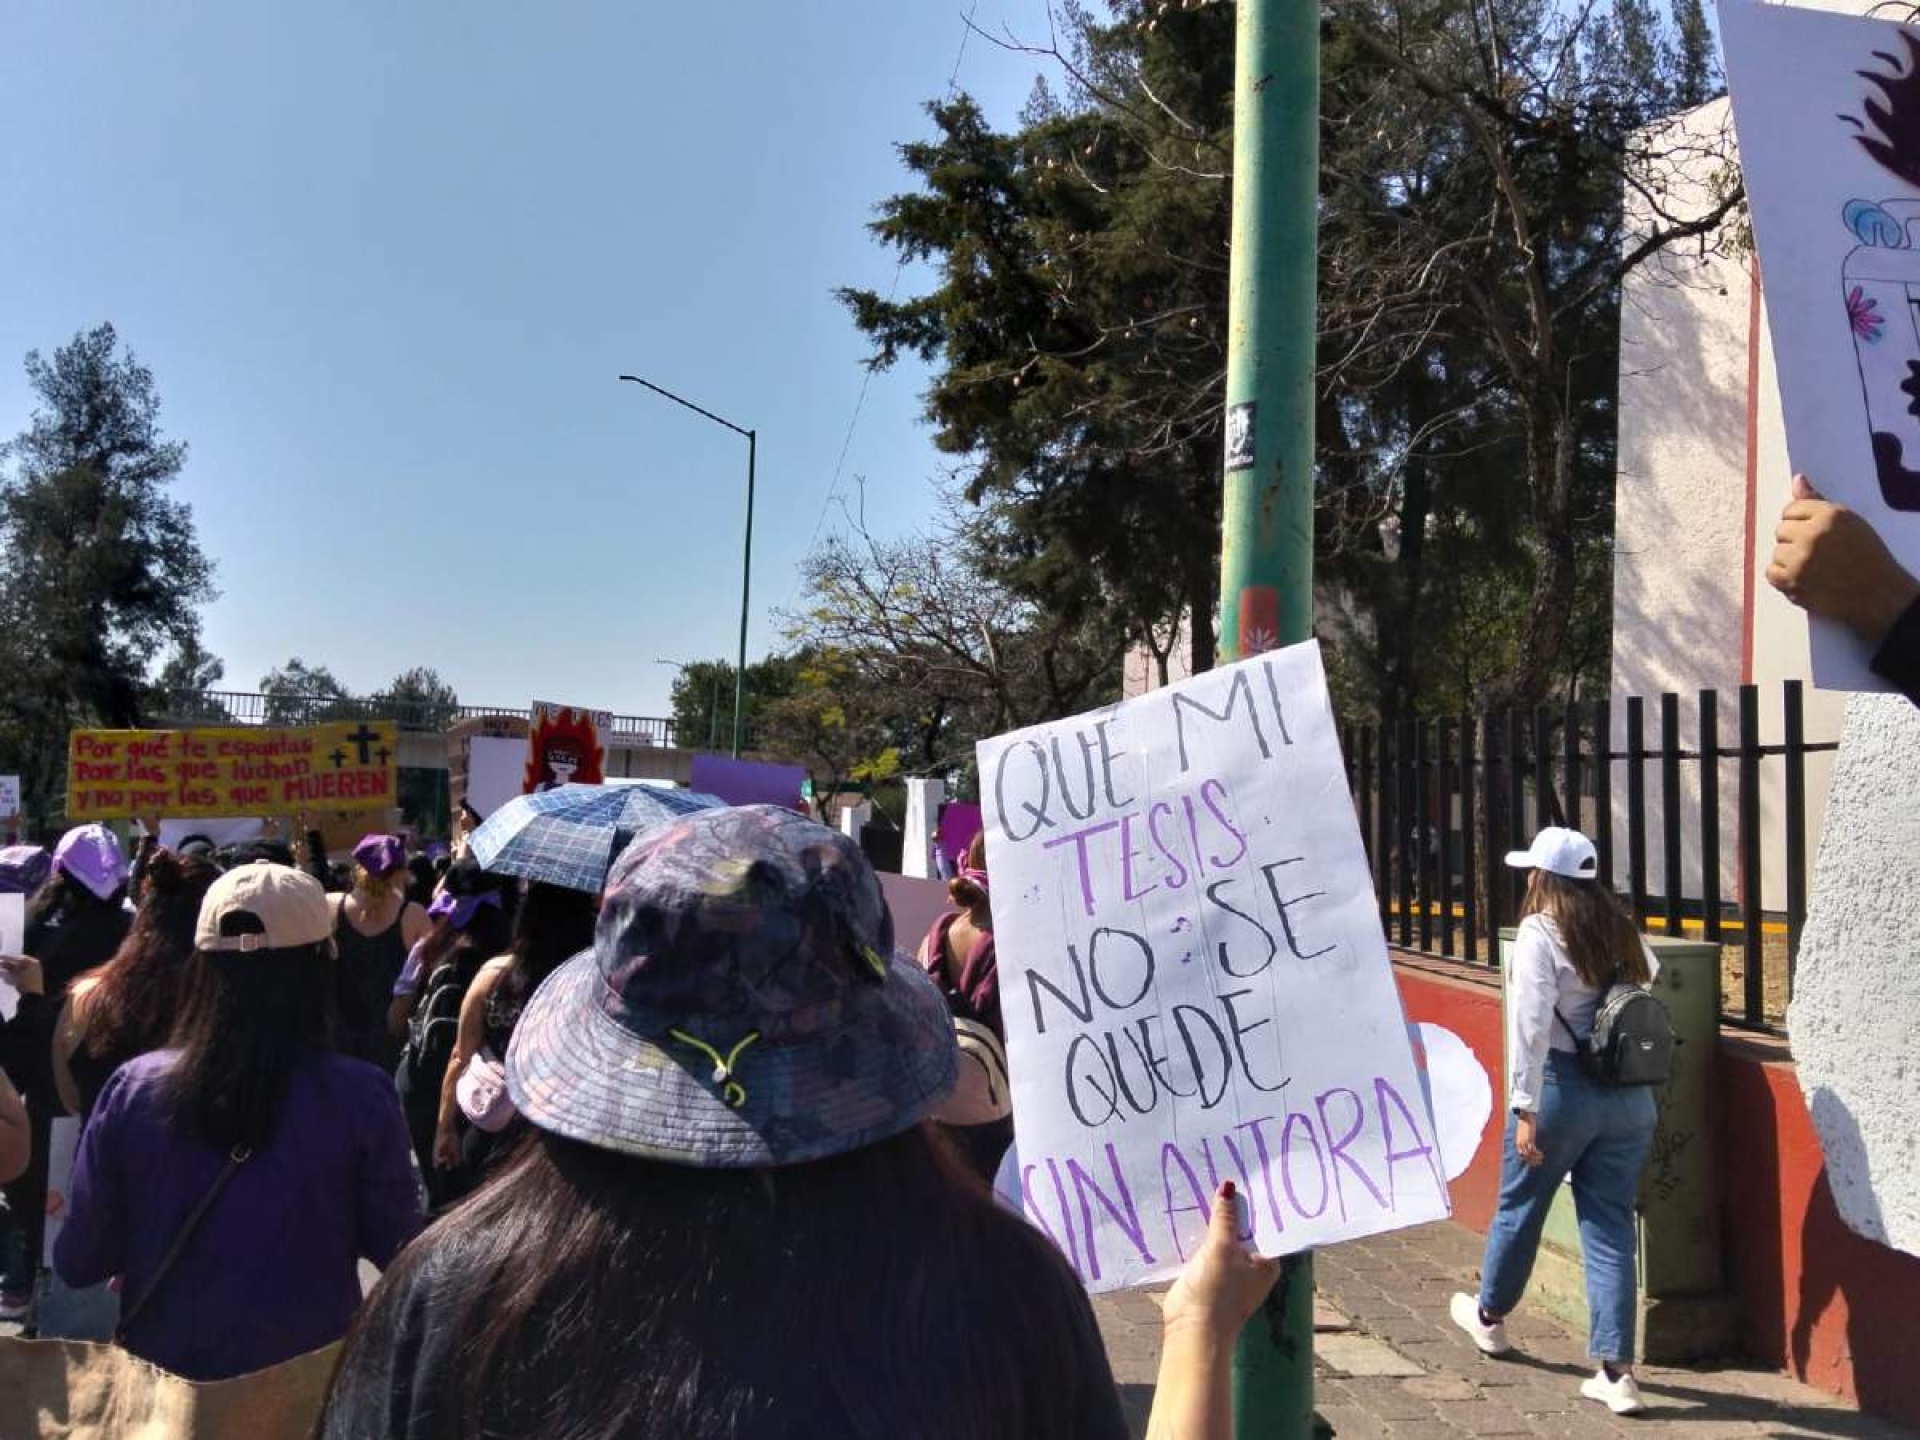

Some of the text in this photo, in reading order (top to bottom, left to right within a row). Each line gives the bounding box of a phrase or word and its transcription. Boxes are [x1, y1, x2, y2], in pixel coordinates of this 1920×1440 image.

[76, 733, 314, 764] Por qué te espantas
[76, 769, 388, 812] y no por las que MUEREN
[127, 757, 166, 784] las
[176, 761, 219, 787] que
[995, 661, 1293, 842] QUE MI
[1044, 779, 1248, 916] TESIS
[1025, 857, 1336, 1034] NO SE
[1065, 989, 1291, 1128] QUEDE
[1161, 1077, 1451, 1263] AUTORA
